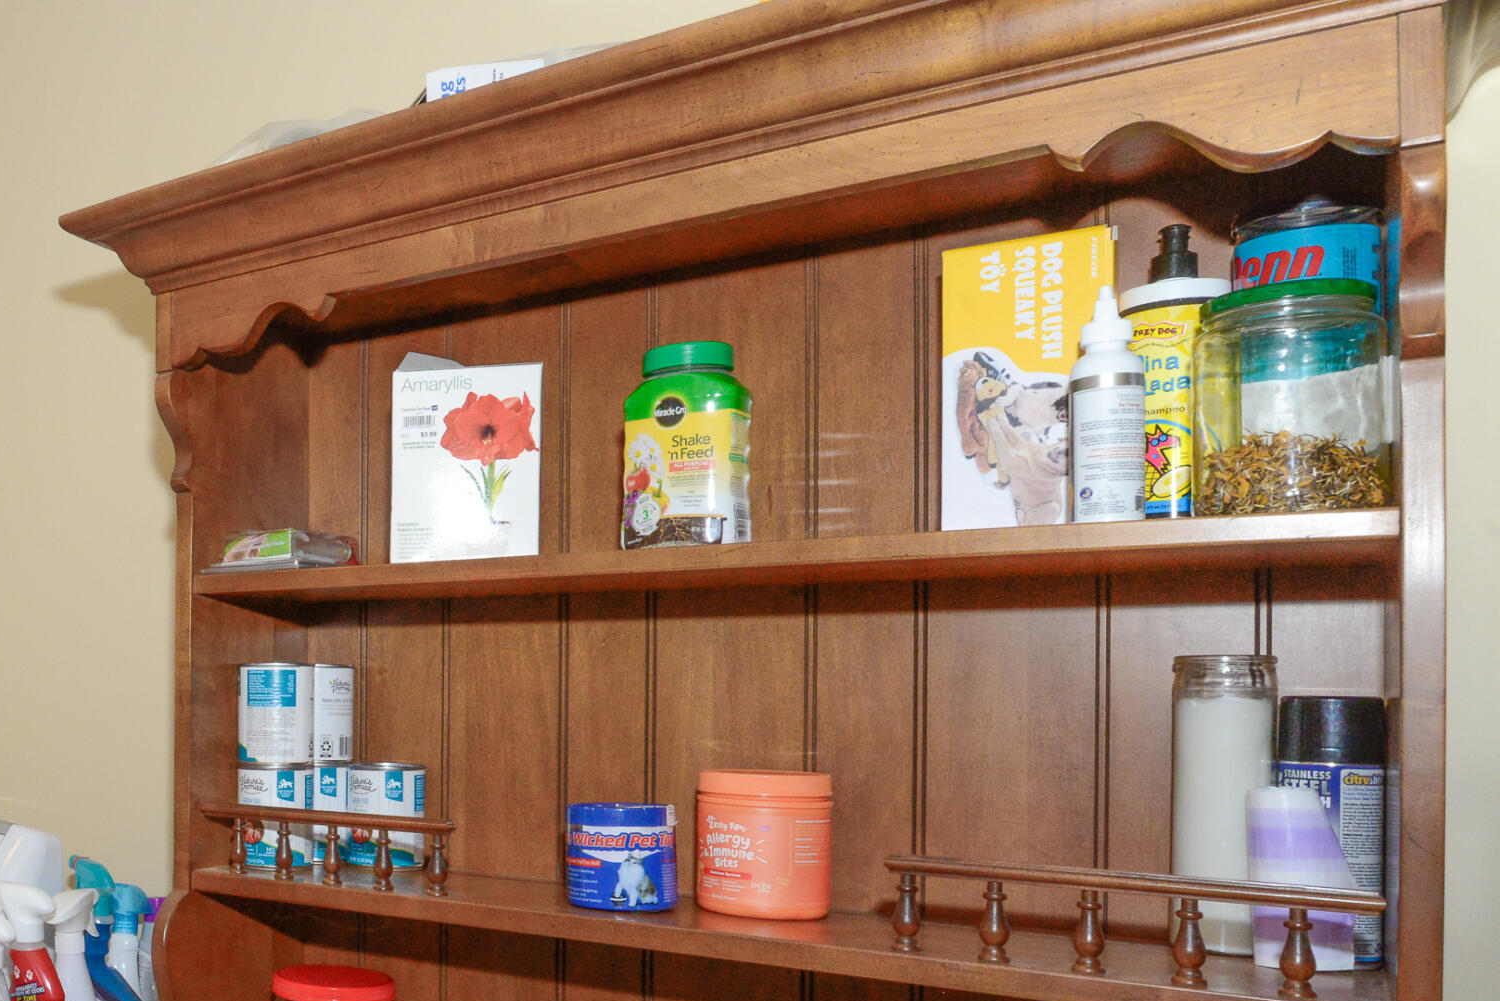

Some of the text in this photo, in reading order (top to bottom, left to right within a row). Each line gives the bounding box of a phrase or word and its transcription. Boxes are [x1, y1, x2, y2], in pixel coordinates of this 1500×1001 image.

[1012, 245, 1036, 340] SQUEAKY
[1041, 241, 1064, 359] DOG PLUSH
[1134, 328, 1156, 336] RAZY
[401, 376, 473, 394] Amaryllis
[1145, 406, 1186, 415] hampoo
[672, 433, 711, 448] Shake
[680, 446, 714, 460] Feed
[1284, 769, 1331, 779] STAINLESS
[709, 821, 728, 831] Zesty
[628, 834, 657, 848] Pet
[707, 832, 750, 850] Allergy
[708, 845, 755, 861] Immune
[715, 857, 739, 868] Bites
